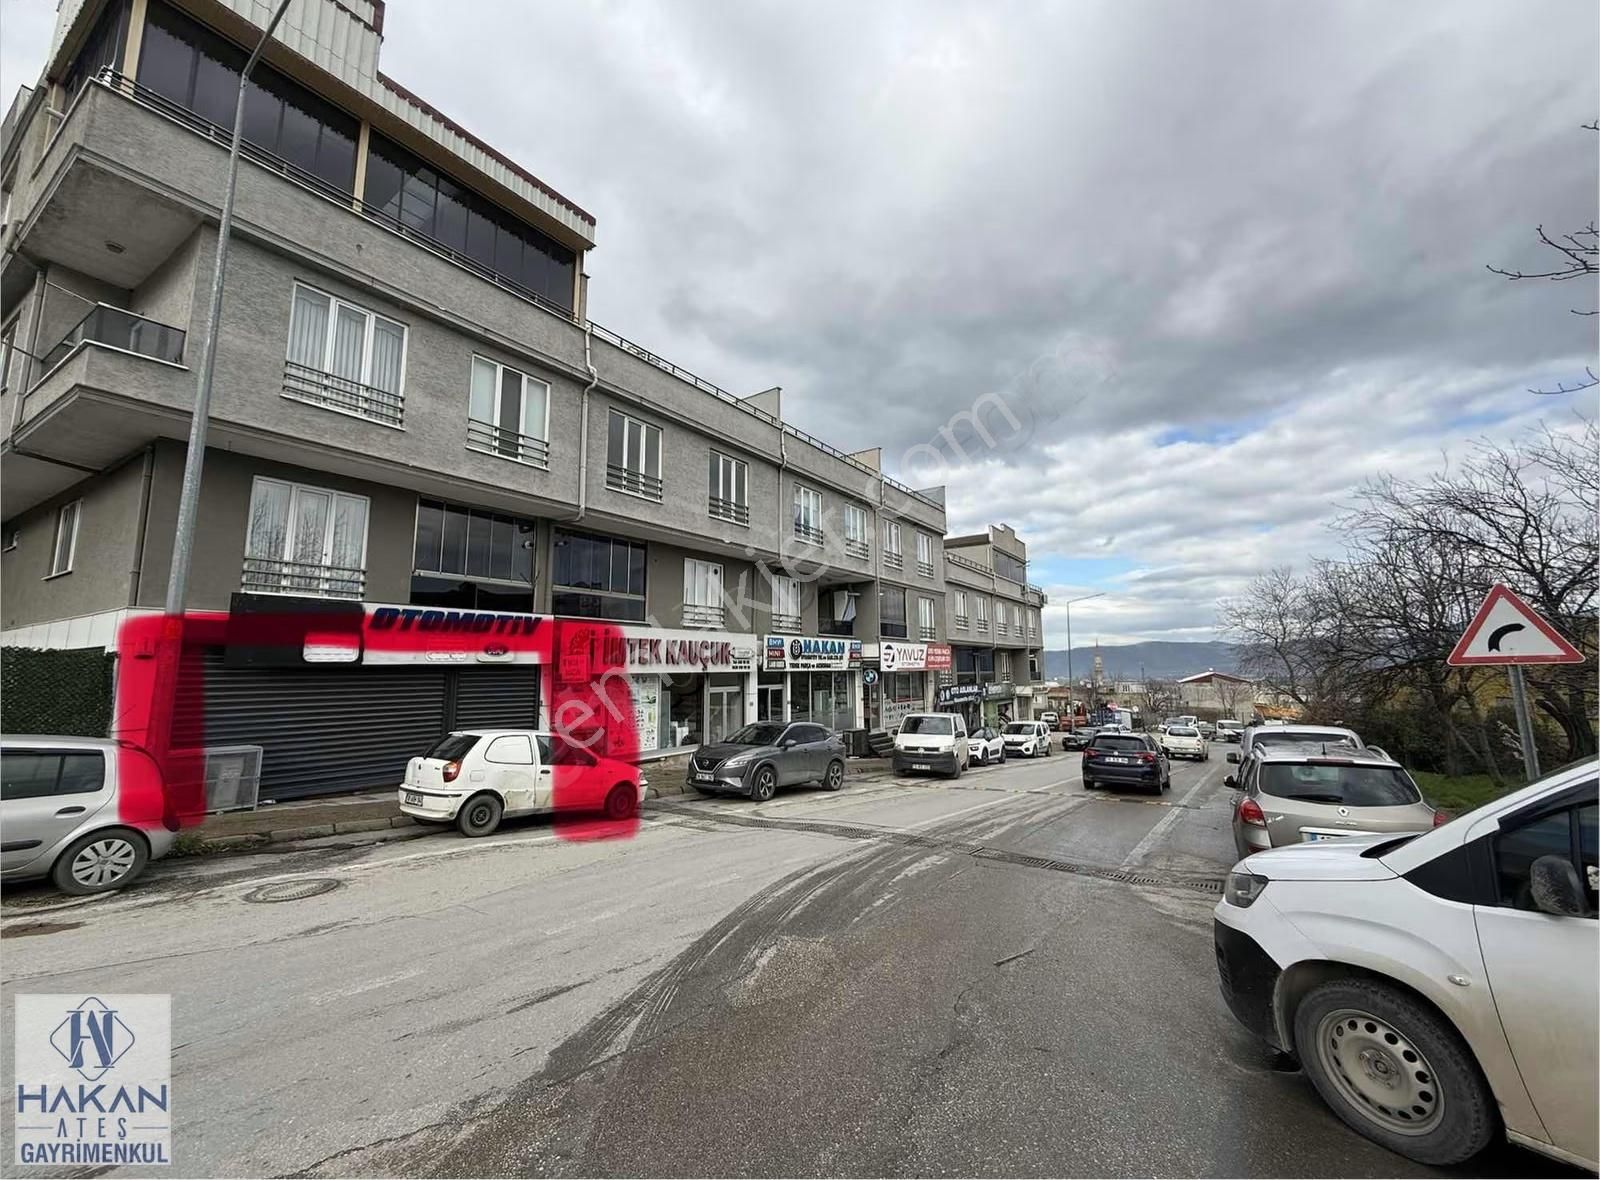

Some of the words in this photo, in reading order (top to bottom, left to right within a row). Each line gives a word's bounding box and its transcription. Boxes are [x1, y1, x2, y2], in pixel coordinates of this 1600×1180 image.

[665, 639, 732, 671] KAUÇUK
[803, 639, 845, 655] HAKAN
[896, 647, 925, 662] YAVUZ
